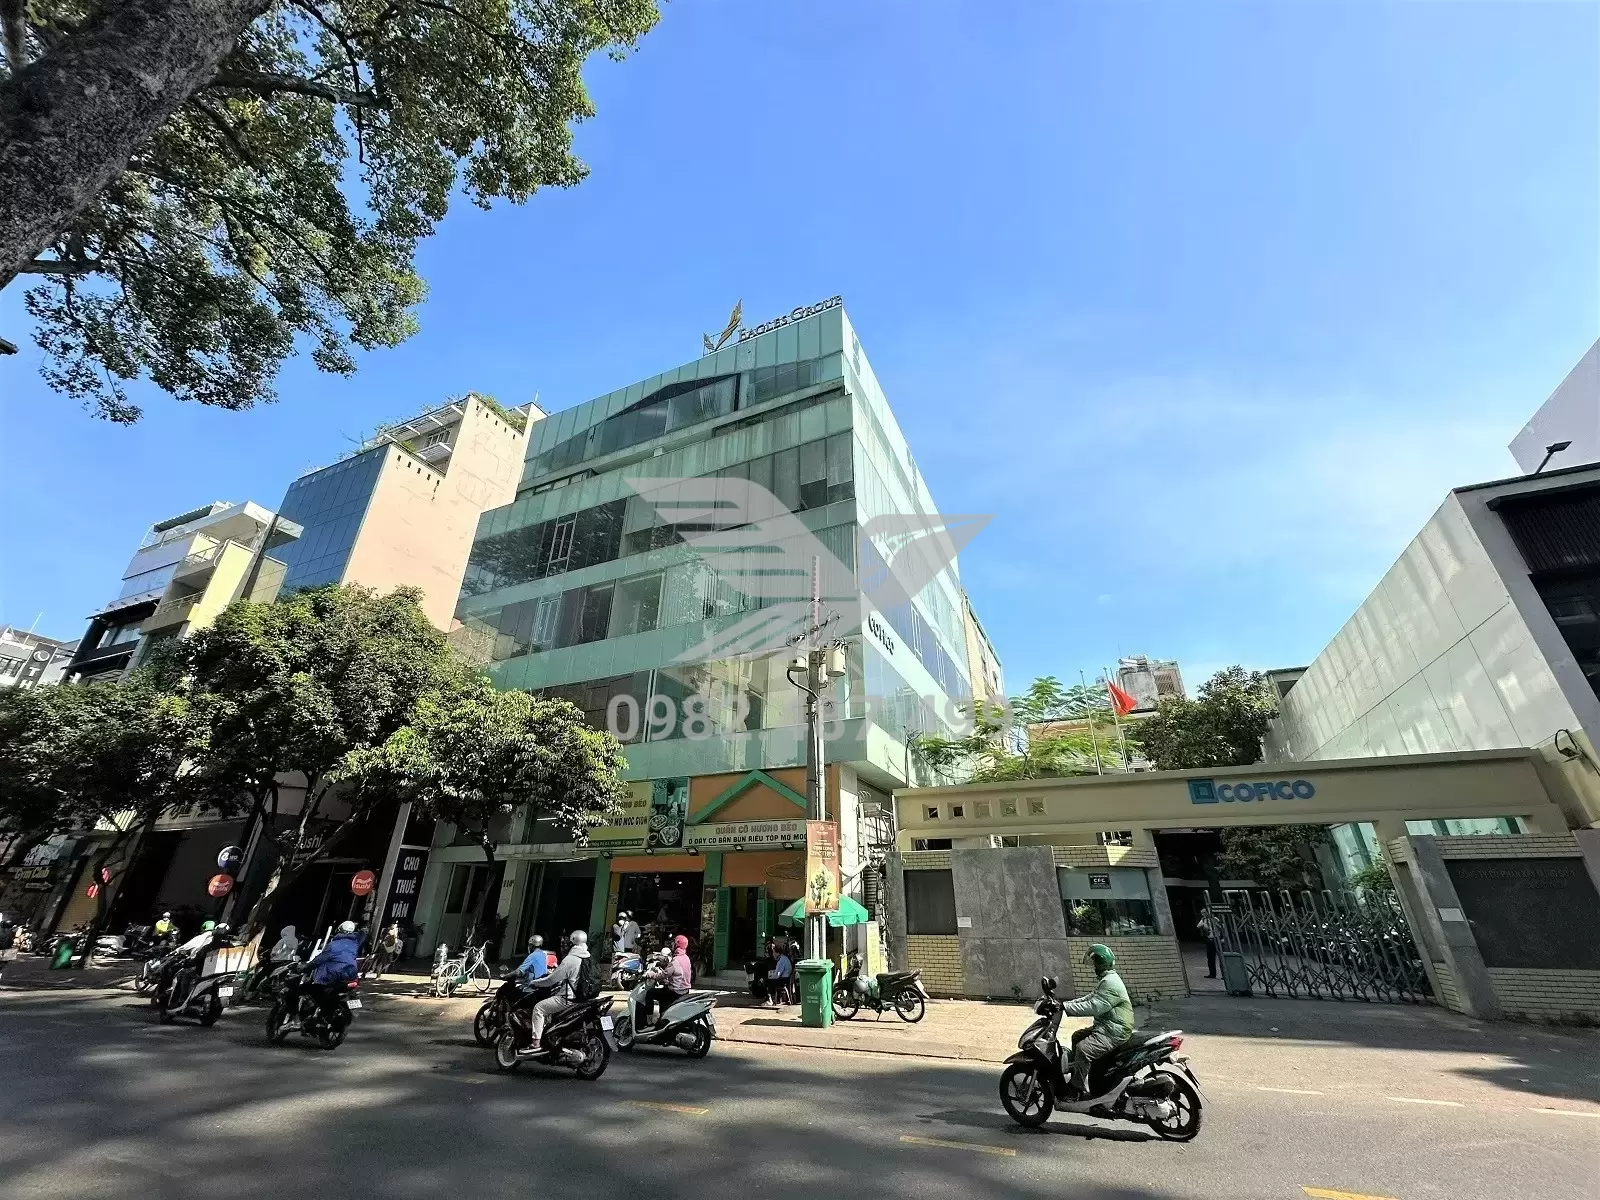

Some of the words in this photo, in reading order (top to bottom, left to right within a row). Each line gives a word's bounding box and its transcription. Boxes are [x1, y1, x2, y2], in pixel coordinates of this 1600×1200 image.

[1217, 780, 1315, 803] COFICO
[403, 856, 420, 871] CHO
[395, 877, 417, 894] THUÊ
[391, 900, 410, 918] VĂN
